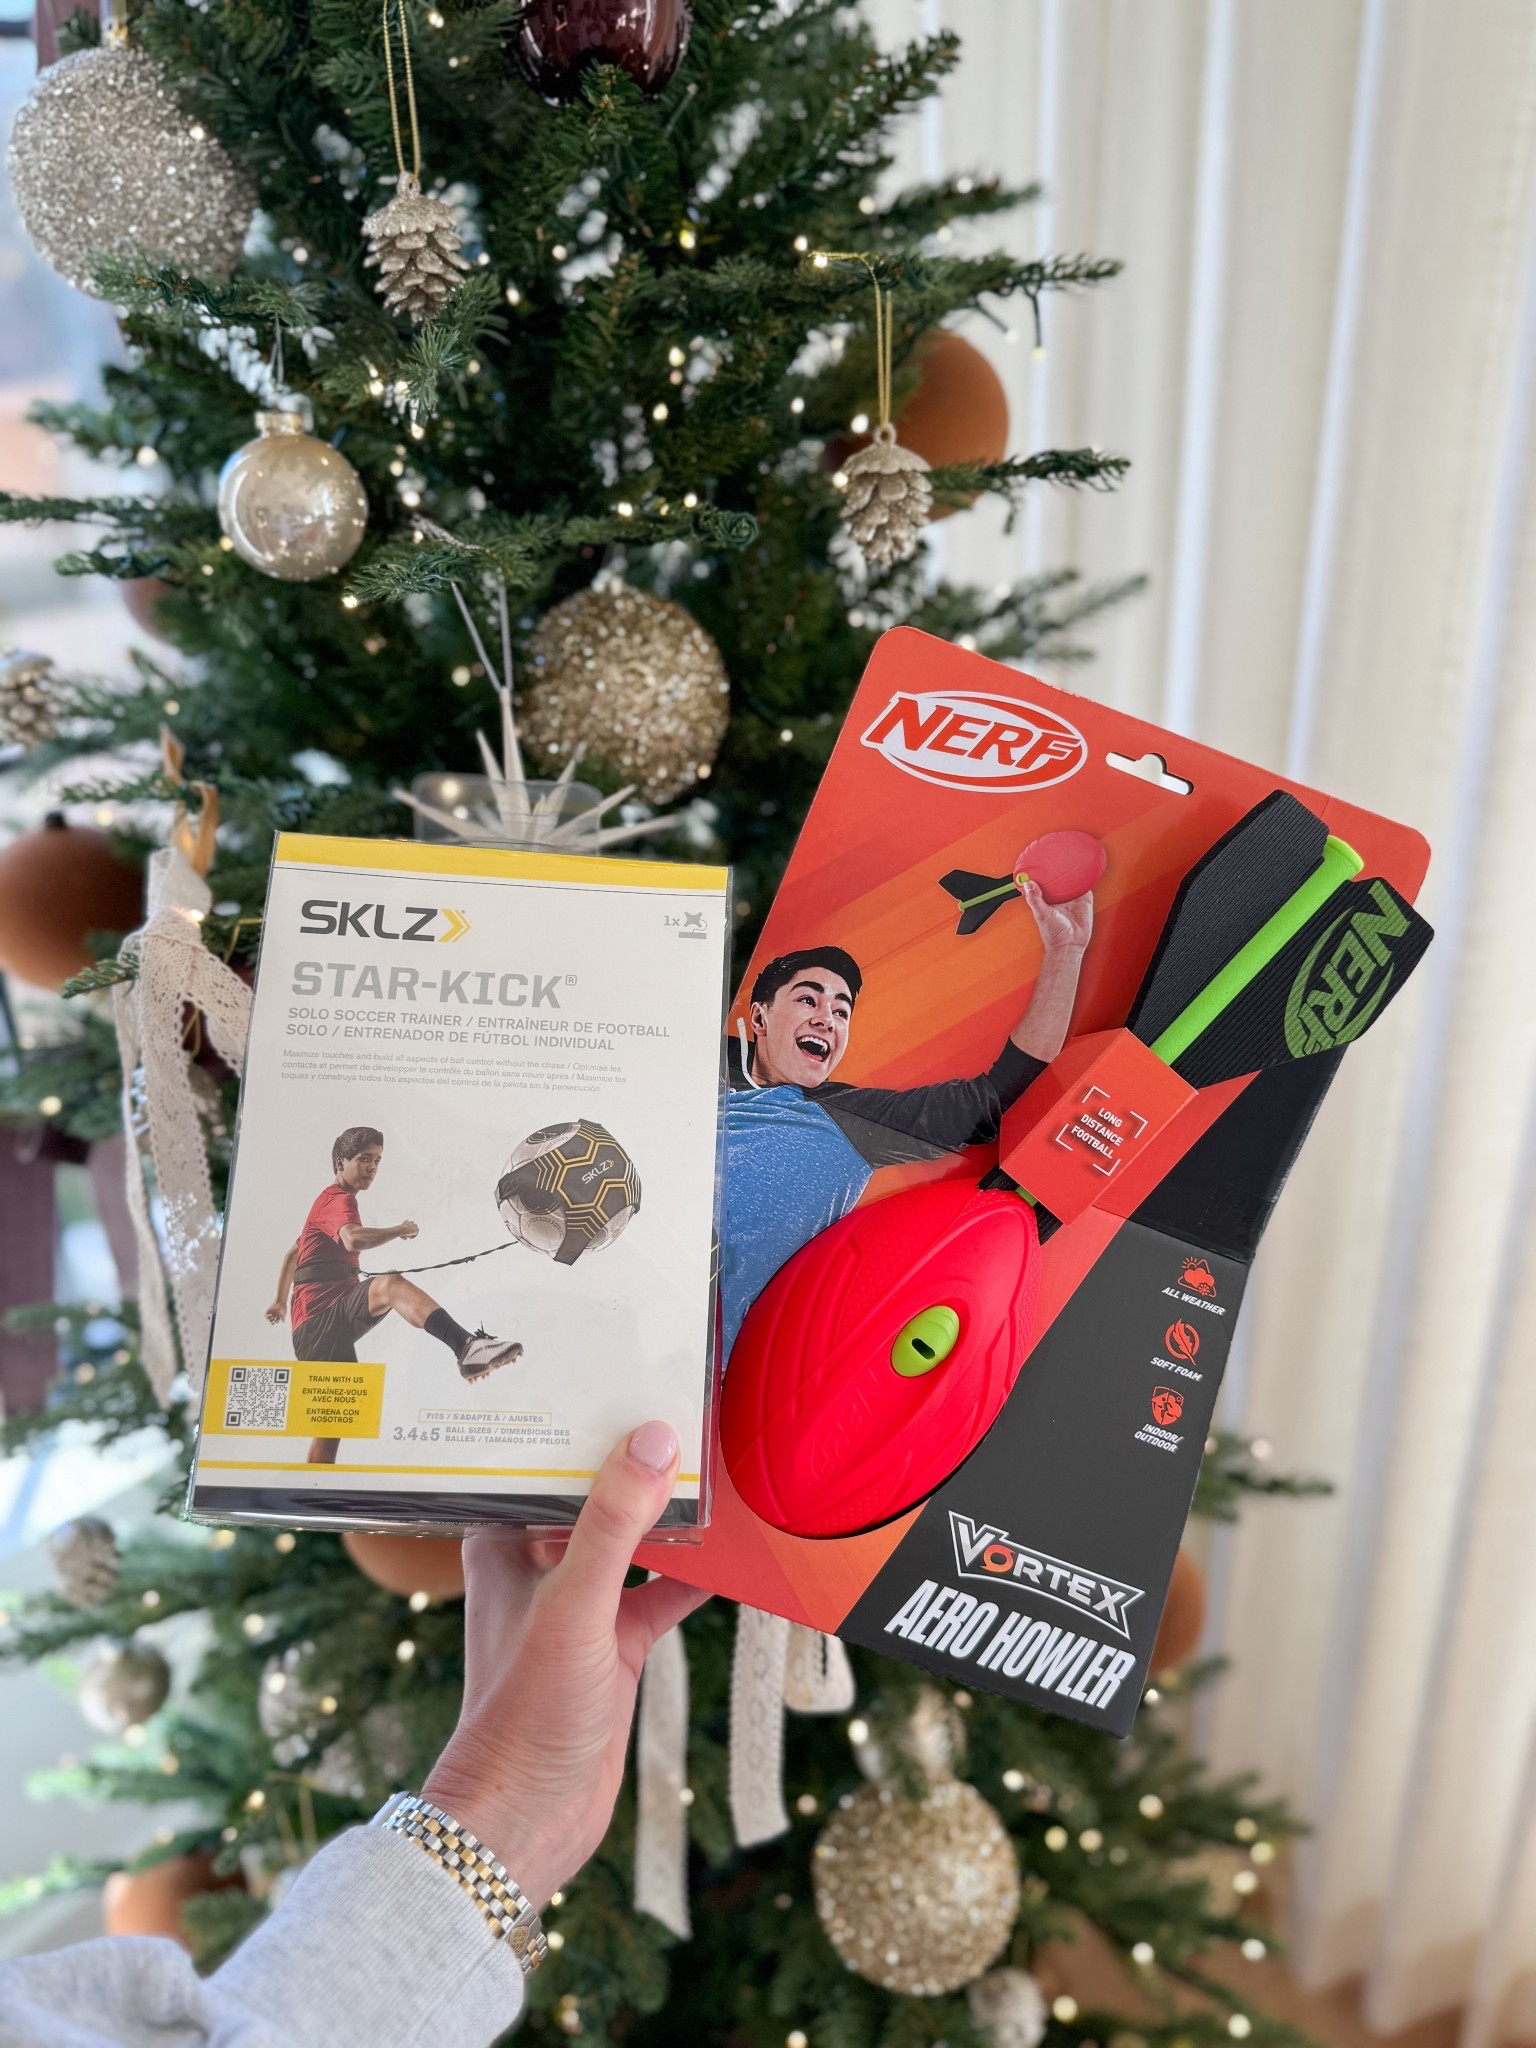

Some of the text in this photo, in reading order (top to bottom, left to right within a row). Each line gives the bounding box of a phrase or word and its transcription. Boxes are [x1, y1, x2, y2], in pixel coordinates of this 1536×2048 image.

[865, 696, 1082, 770] NERF
[300, 899, 438, 942] SKLZ
[663, 915, 680, 926] 1x
[1297, 880, 1411, 1056] NERF
[288, 1007, 330, 1020] SOLO
[334, 1009, 396, 1024] SOCCER
[401, 1012, 462, 1026] TRAINER
[478, 1016, 569, 1032] ENTRAÎNEUR
[573, 1021, 593, 1033] DE
[597, 1022, 671, 1038] FOOTBALL
[286, 1023, 328, 1036] SOLO
[344, 1026, 444, 1042] ENTRENADOR
[448, 1031, 469, 1043] DE
[473, 1030, 529, 1046] FÚTBOL
[534, 1035, 615, 1051] INDIVIDUAL
[1080, 1113, 1124, 1146] DISTANCE
[1098, 1107, 1123, 1128] LONG
[1071, 1125, 1114, 1159] FOOTBALL
[581, 1161, 610, 1184] SKLZ
[1161, 1286, 1226, 1316] ALL WEATHER
[1151, 1356, 1203, 1382] SOFT FOAM
[302, 1387, 368, 1396] ENTRAÎNEZ-VOUS
[426, 1412, 444, 1420] FITS
[453, 1413, 492, 1421] S'ADAPTE
[508, 1415, 544, 1423] AJUSTES
[501, 1428, 551, 1436] DIMENSIONS
[1134, 1431, 1179, 1454] OUTDOOR
[1142, 1423, 1184, 1444] INDOOR/
[958, 1521, 1129, 1623] VORTEX
[883, 1579, 1136, 1710] AERO HOWLER
